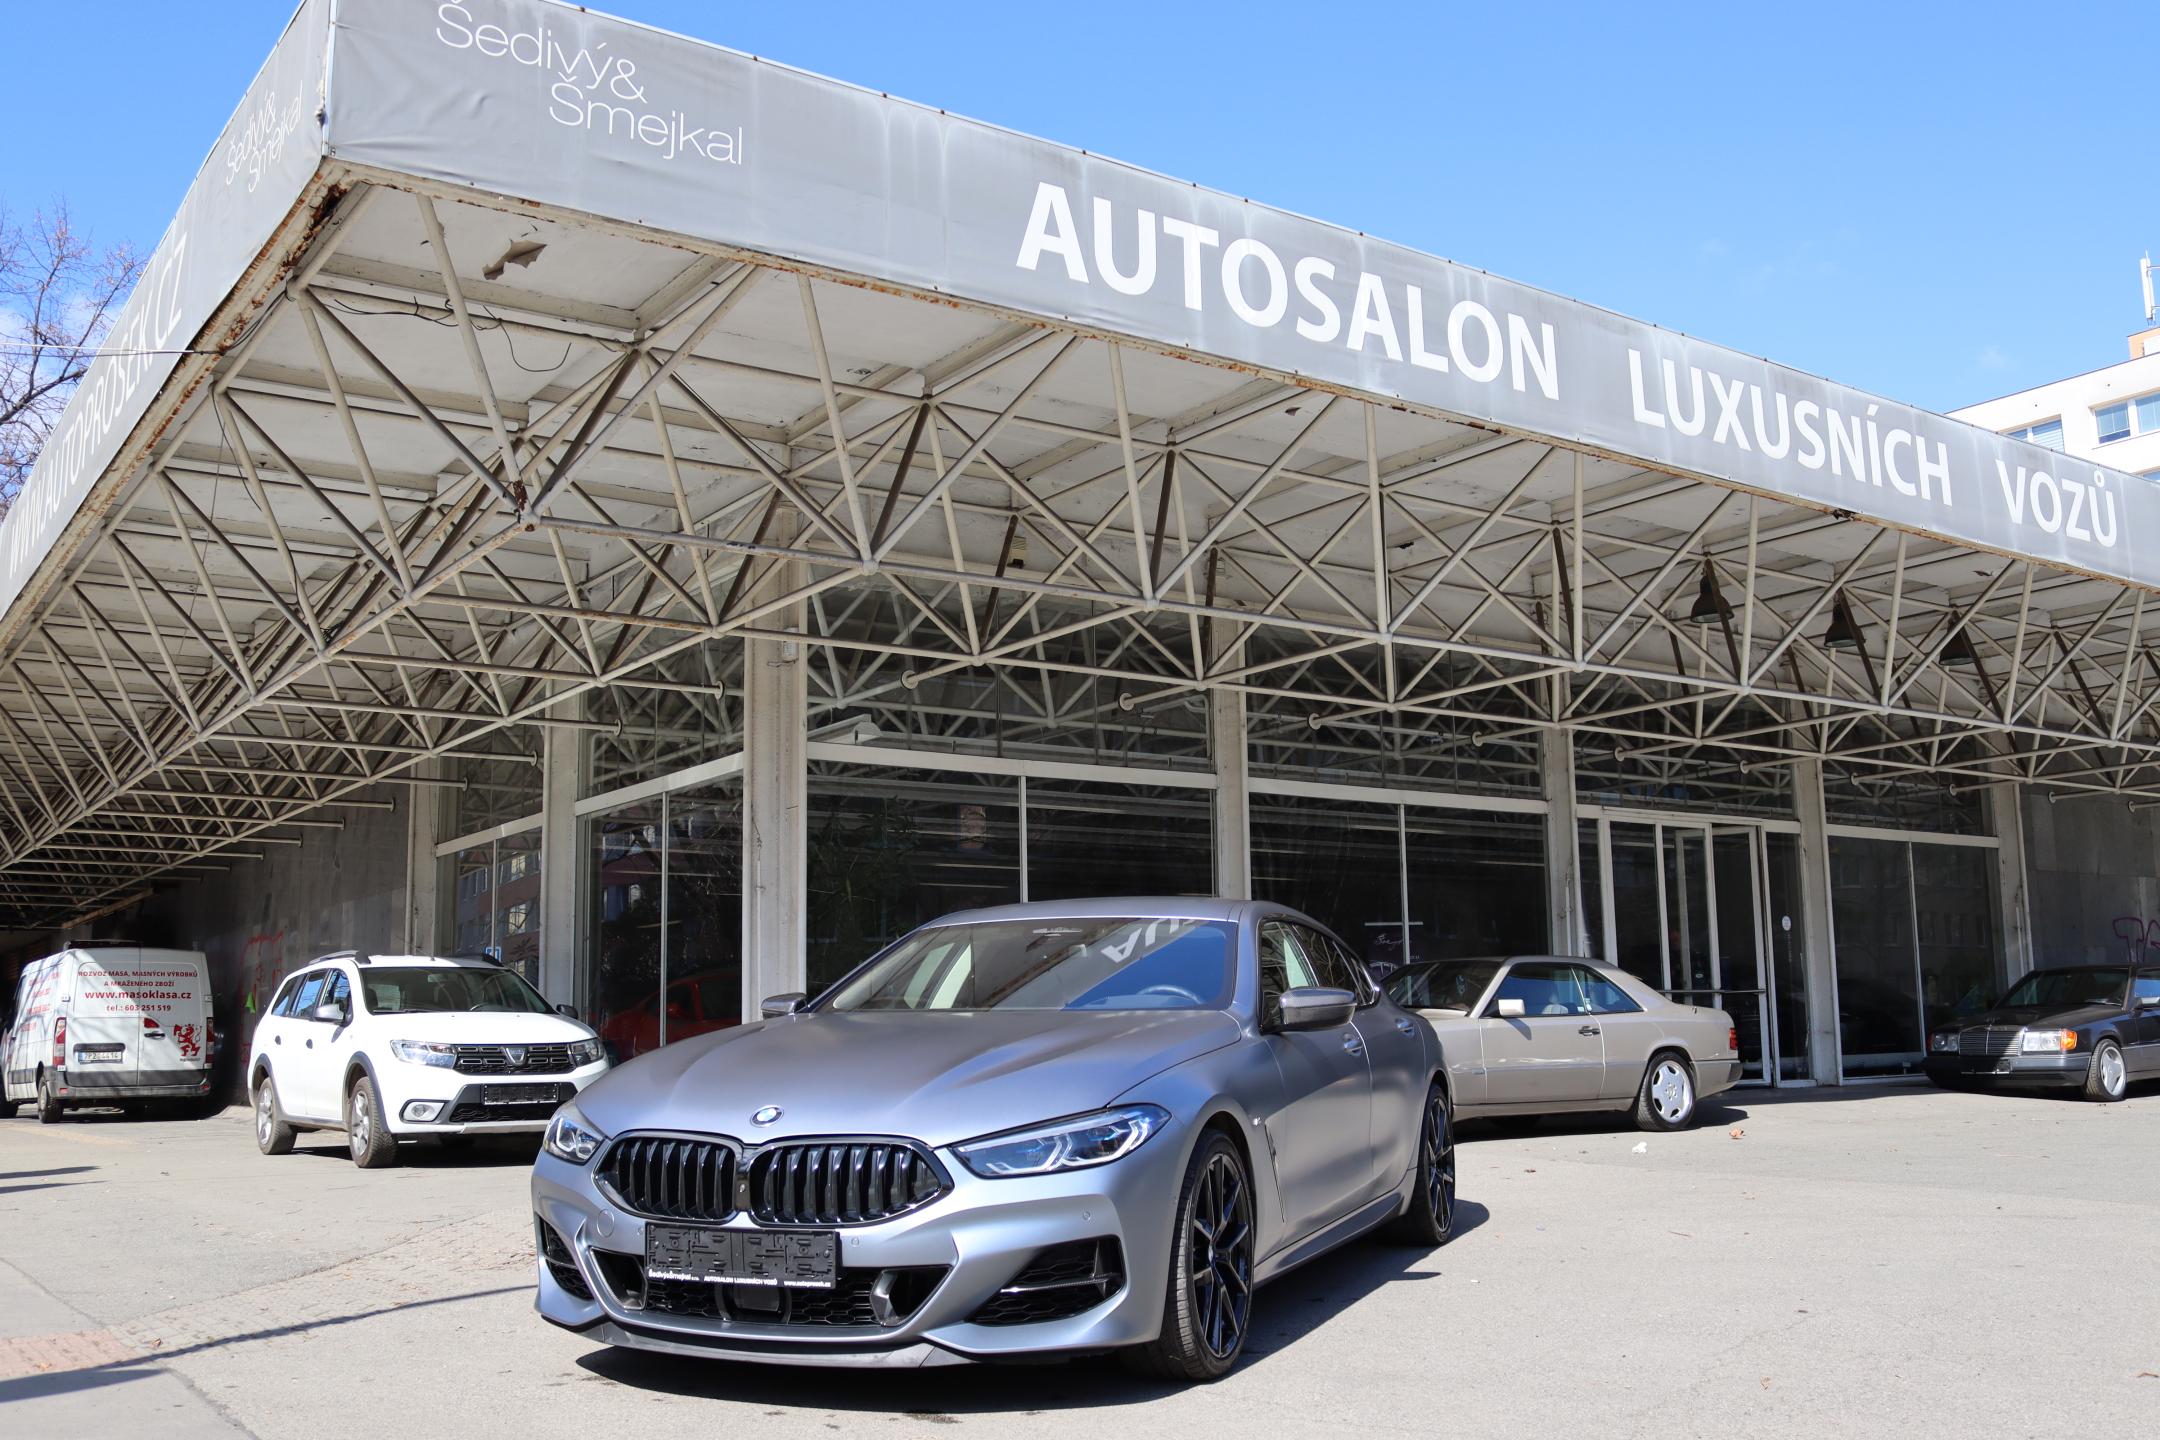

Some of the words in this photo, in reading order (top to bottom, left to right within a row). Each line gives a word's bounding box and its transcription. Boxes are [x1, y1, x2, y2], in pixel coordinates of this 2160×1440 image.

[549, 71, 743, 165] Šmejkal
[1015, 181, 1560, 401] AUTOSALON
[1627, 348, 1953, 507] LUXUSNÍCH
[1995, 458, 2118, 548] VOZŮ
[85, 990, 192, 999] www.masoklasa.cz
[124, 1004, 140, 1012] 603
[141, 1004, 155, 1012] 251
[157, 1004, 171, 1012] 519
